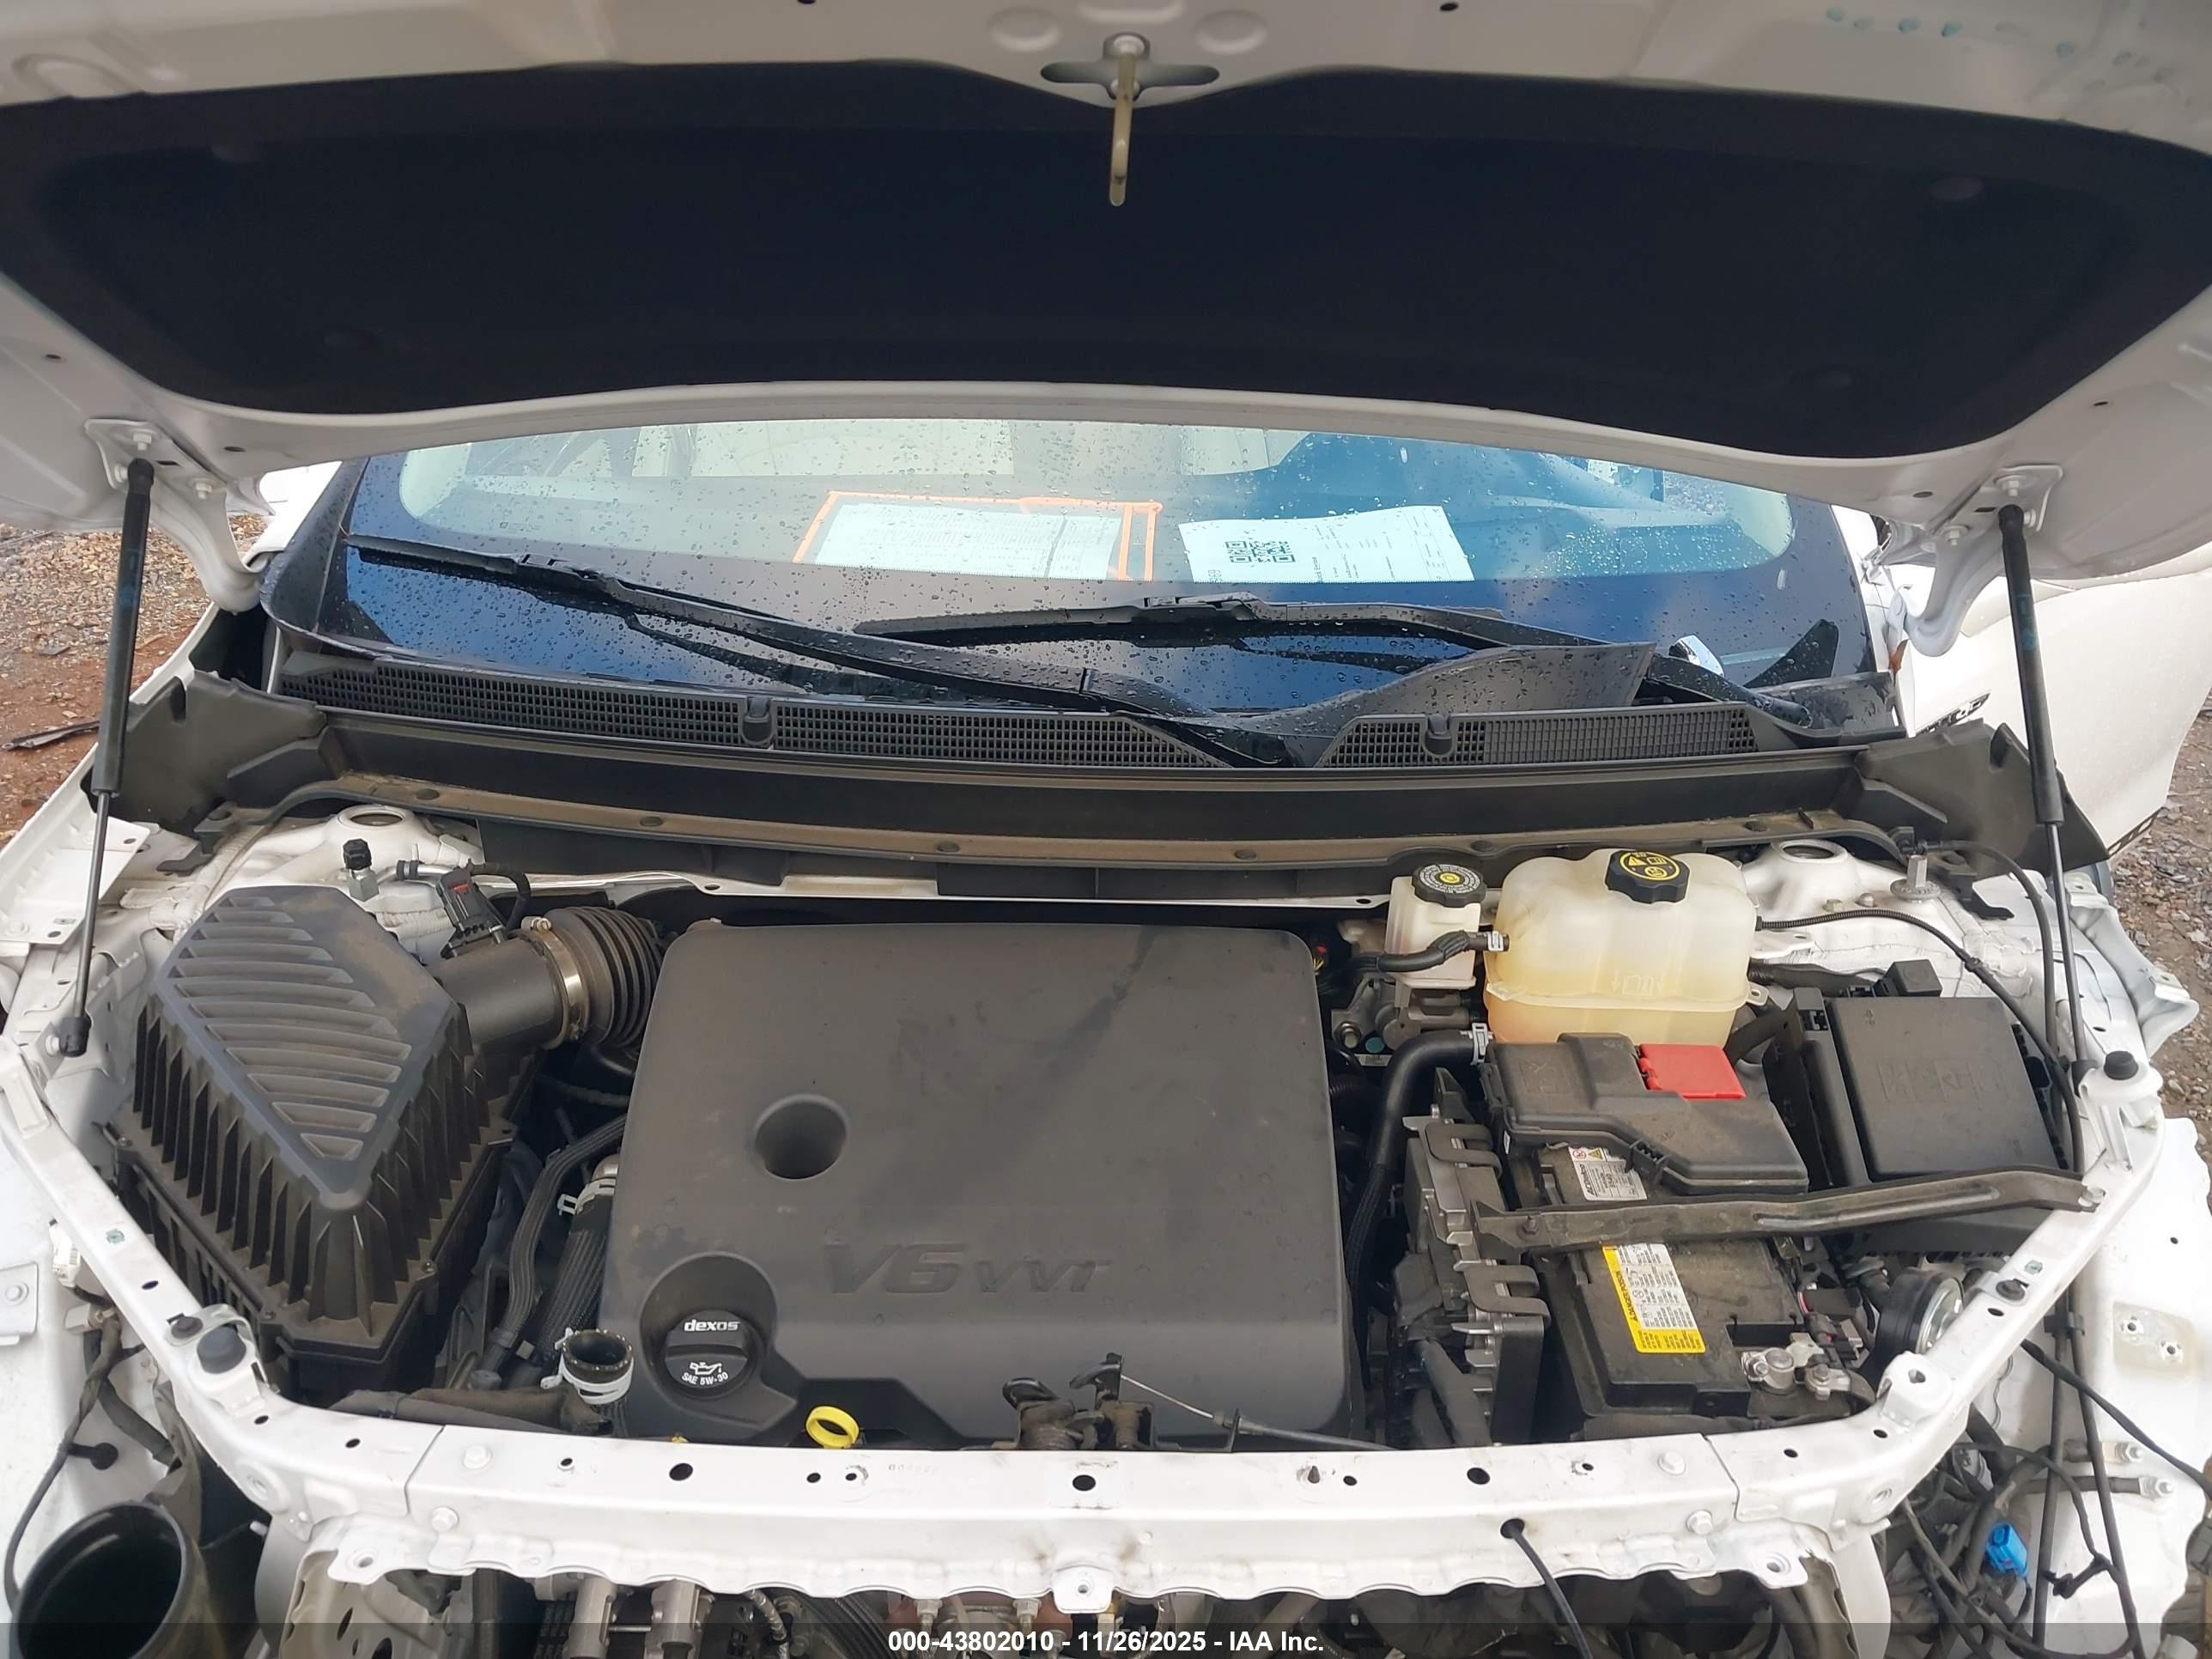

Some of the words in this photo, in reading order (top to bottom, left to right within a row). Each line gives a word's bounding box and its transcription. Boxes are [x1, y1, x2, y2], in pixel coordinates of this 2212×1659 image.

[824, 1243, 968, 1292] V6
[974, 1259, 1114, 1292] VVT
[684, 1319, 741, 1332] dexos
[681, 1371, 699, 1385] SAE
[700, 1371, 729, 1386] 5W-30
